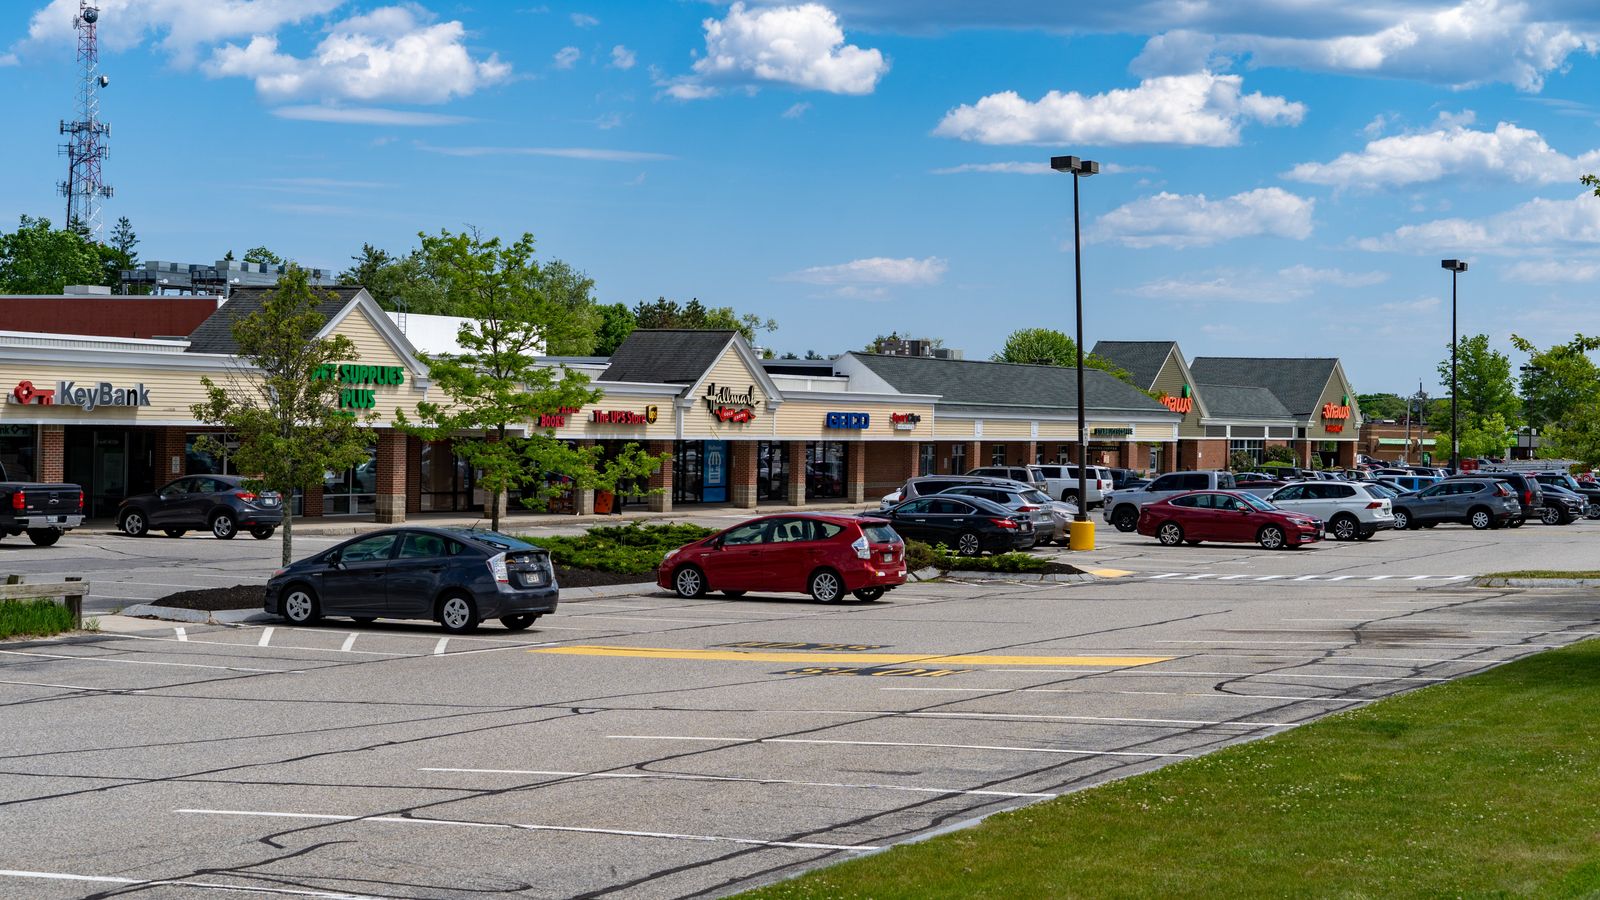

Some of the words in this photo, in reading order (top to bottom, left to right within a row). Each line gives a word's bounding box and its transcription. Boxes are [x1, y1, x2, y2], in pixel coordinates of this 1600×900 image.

[339, 364, 405, 385] SUPPLIES
[58, 381, 151, 411] KeyBank
[339, 388, 376, 409] PLUS
[702, 383, 760, 415] Hallmark
[593, 410, 609, 424] The
[609, 411, 626, 424] UPS
[627, 411, 646, 424] Store
[827, 412, 869, 429] GEICO
